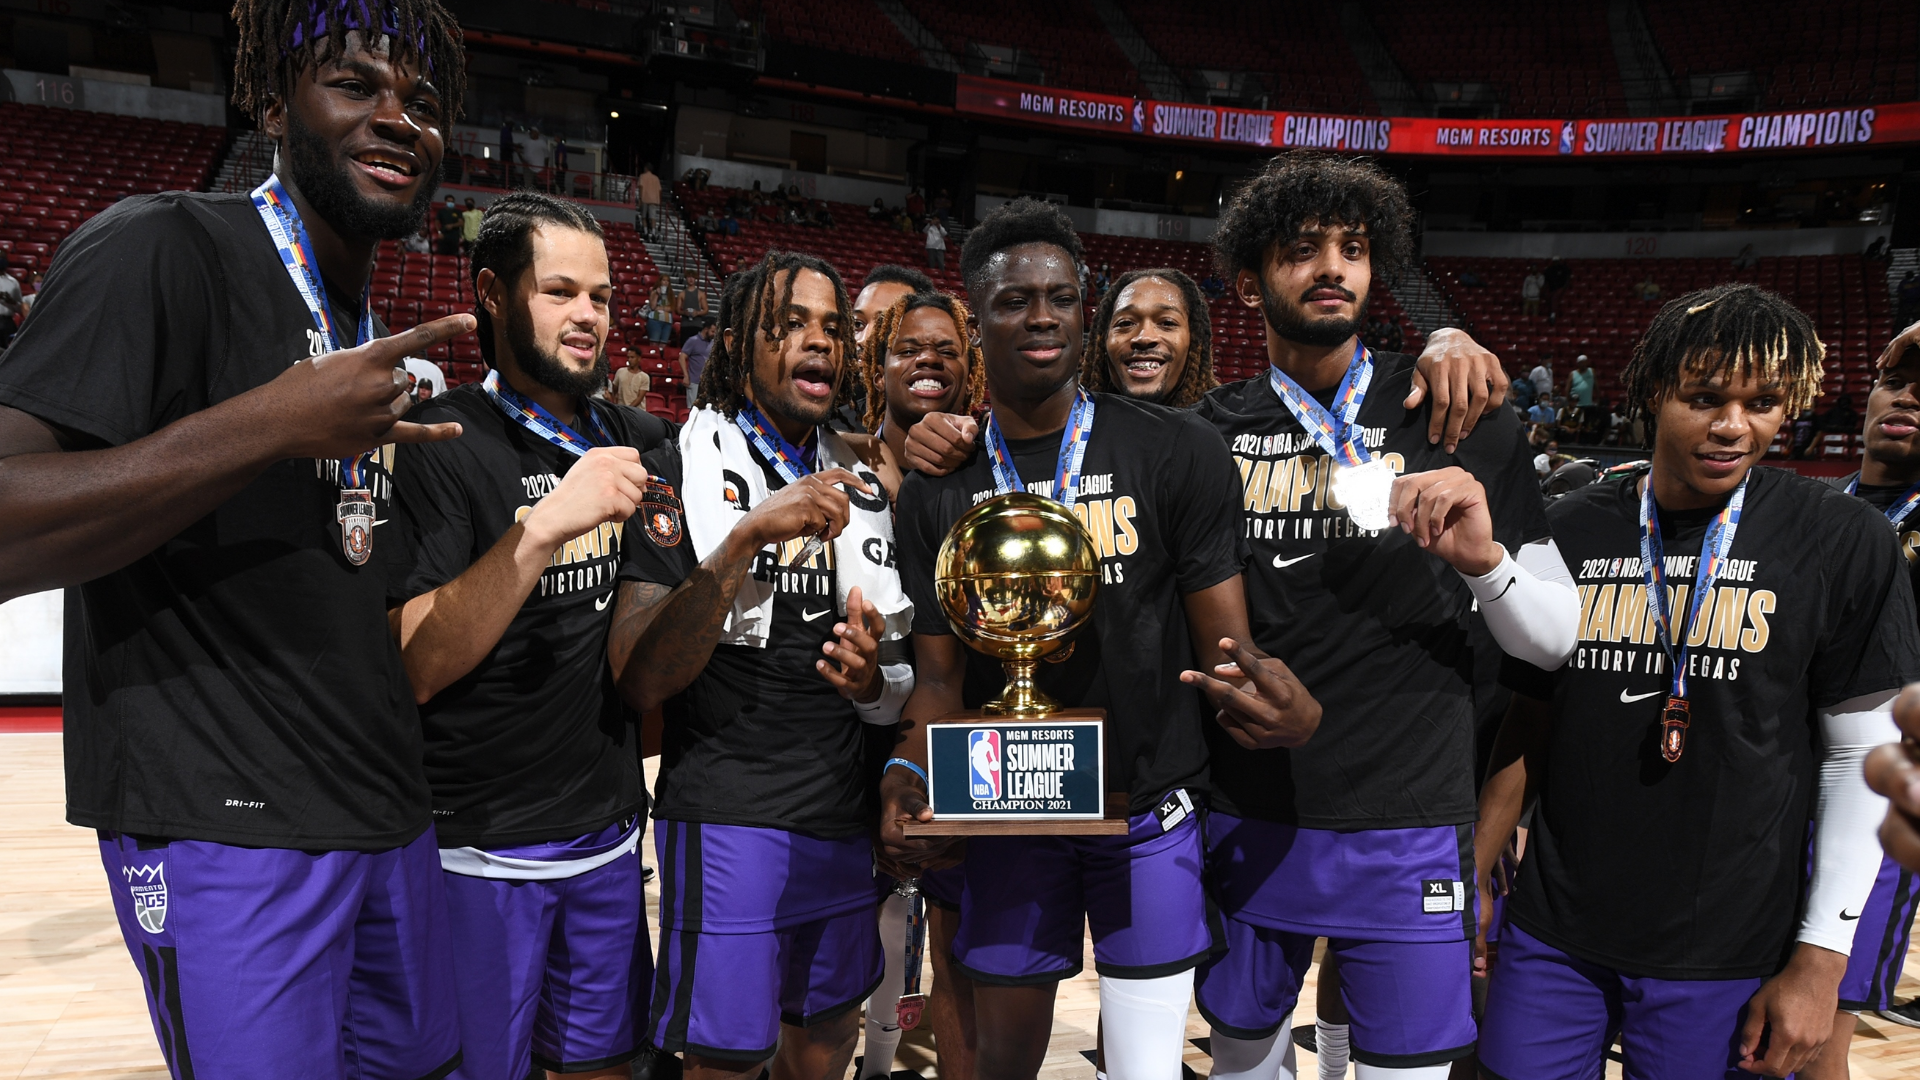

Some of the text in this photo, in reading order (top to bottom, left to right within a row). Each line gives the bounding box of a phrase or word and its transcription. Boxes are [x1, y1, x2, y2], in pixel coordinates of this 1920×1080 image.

[36, 79, 75, 104] 116
[788, 103, 815, 121] 118
[1020, 93, 1390, 150] MGM RESORTS SUMMER LEAGUE CHAMPIONS
[1436, 108, 1875, 153] MGM RESORTS SUMMER LEAGUE CHAMPIONS
[1157, 219, 1183, 237] 119
[1625, 237, 1657, 256] 120
[306, 328, 325, 357] 20
[1231, 427, 1388, 456] 2021 NBA SUM GUE
[1027, 480, 1055, 499] SUM
[1245, 517, 1286, 540] TORY
[1294, 518, 1313, 540] IN
[540, 564, 602, 597] VICTORY
[1579, 555, 1758, 582] 2021 NBA MME AGUE
[773, 572, 830, 596] TORY IN
[1577, 583, 1777, 654] HAMPIONS
[1645, 651, 1665, 675] IN
[1689, 653, 1741, 681] EGAS
[1006, 729, 1075, 740] MGM RESORTS
[1006, 743, 1075, 771] SUMMER
[973, 784, 990, 796] NBA
[1007, 771, 1064, 799] LEAGUE
[225, 798, 266, 809] DRI-FIT
[972, 800, 1072, 810] CHAMPION 2021
[1160, 801, 1177, 816] XL
[1430, 883, 1447, 894] XL
